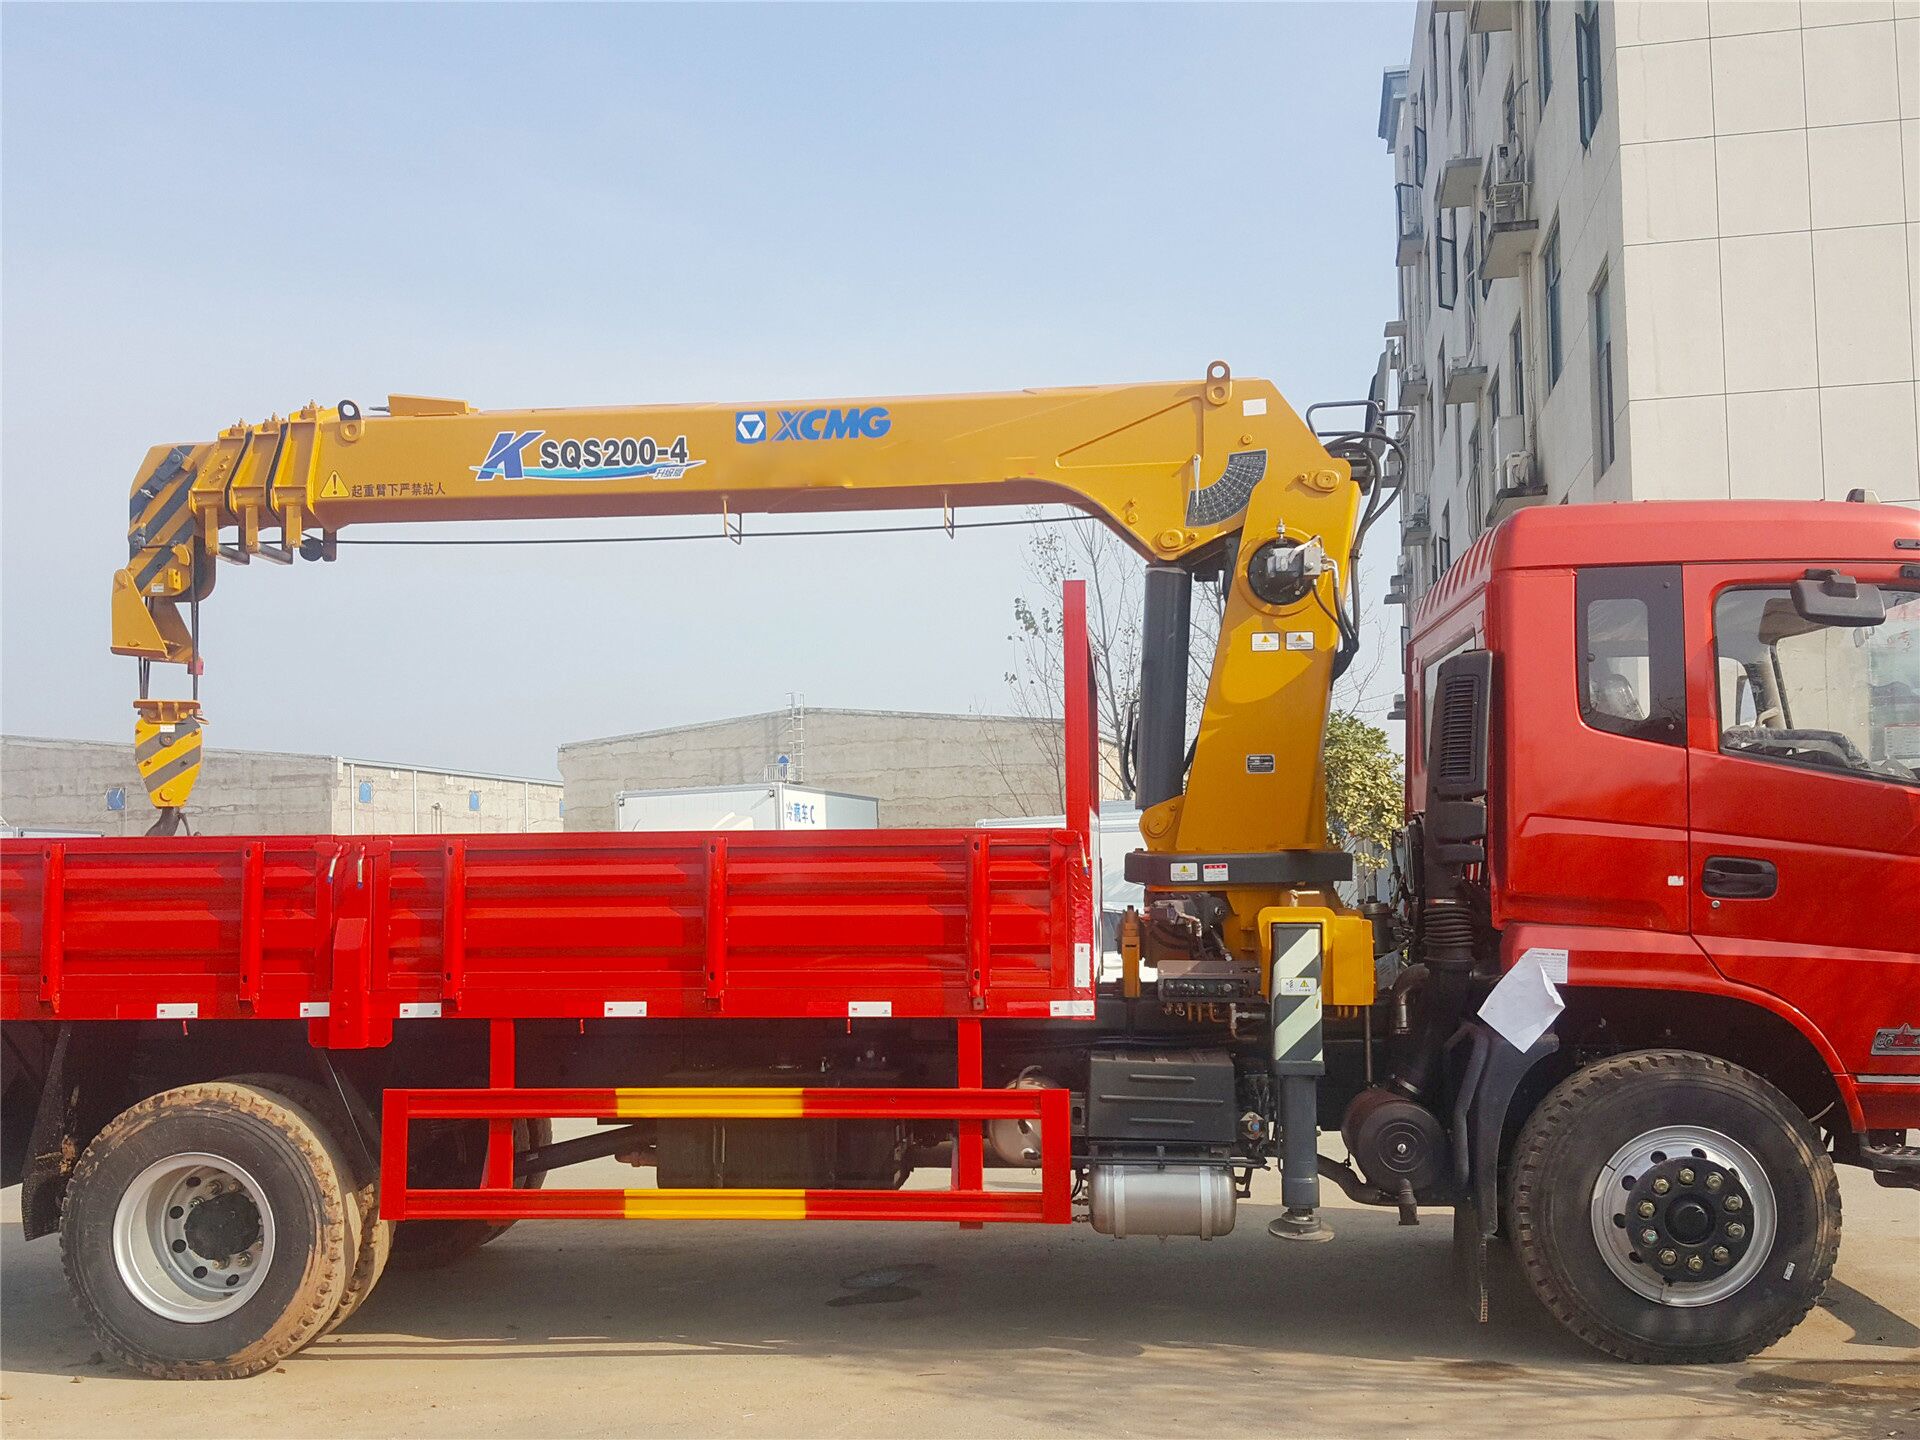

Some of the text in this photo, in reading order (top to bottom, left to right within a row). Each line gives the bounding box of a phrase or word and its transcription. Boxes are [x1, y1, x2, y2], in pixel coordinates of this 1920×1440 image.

[770, 406, 892, 441] XCMG
[540, 436, 688, 470] SQS200-4
[351, 482, 446, 498] 起重臂下严禁站人
